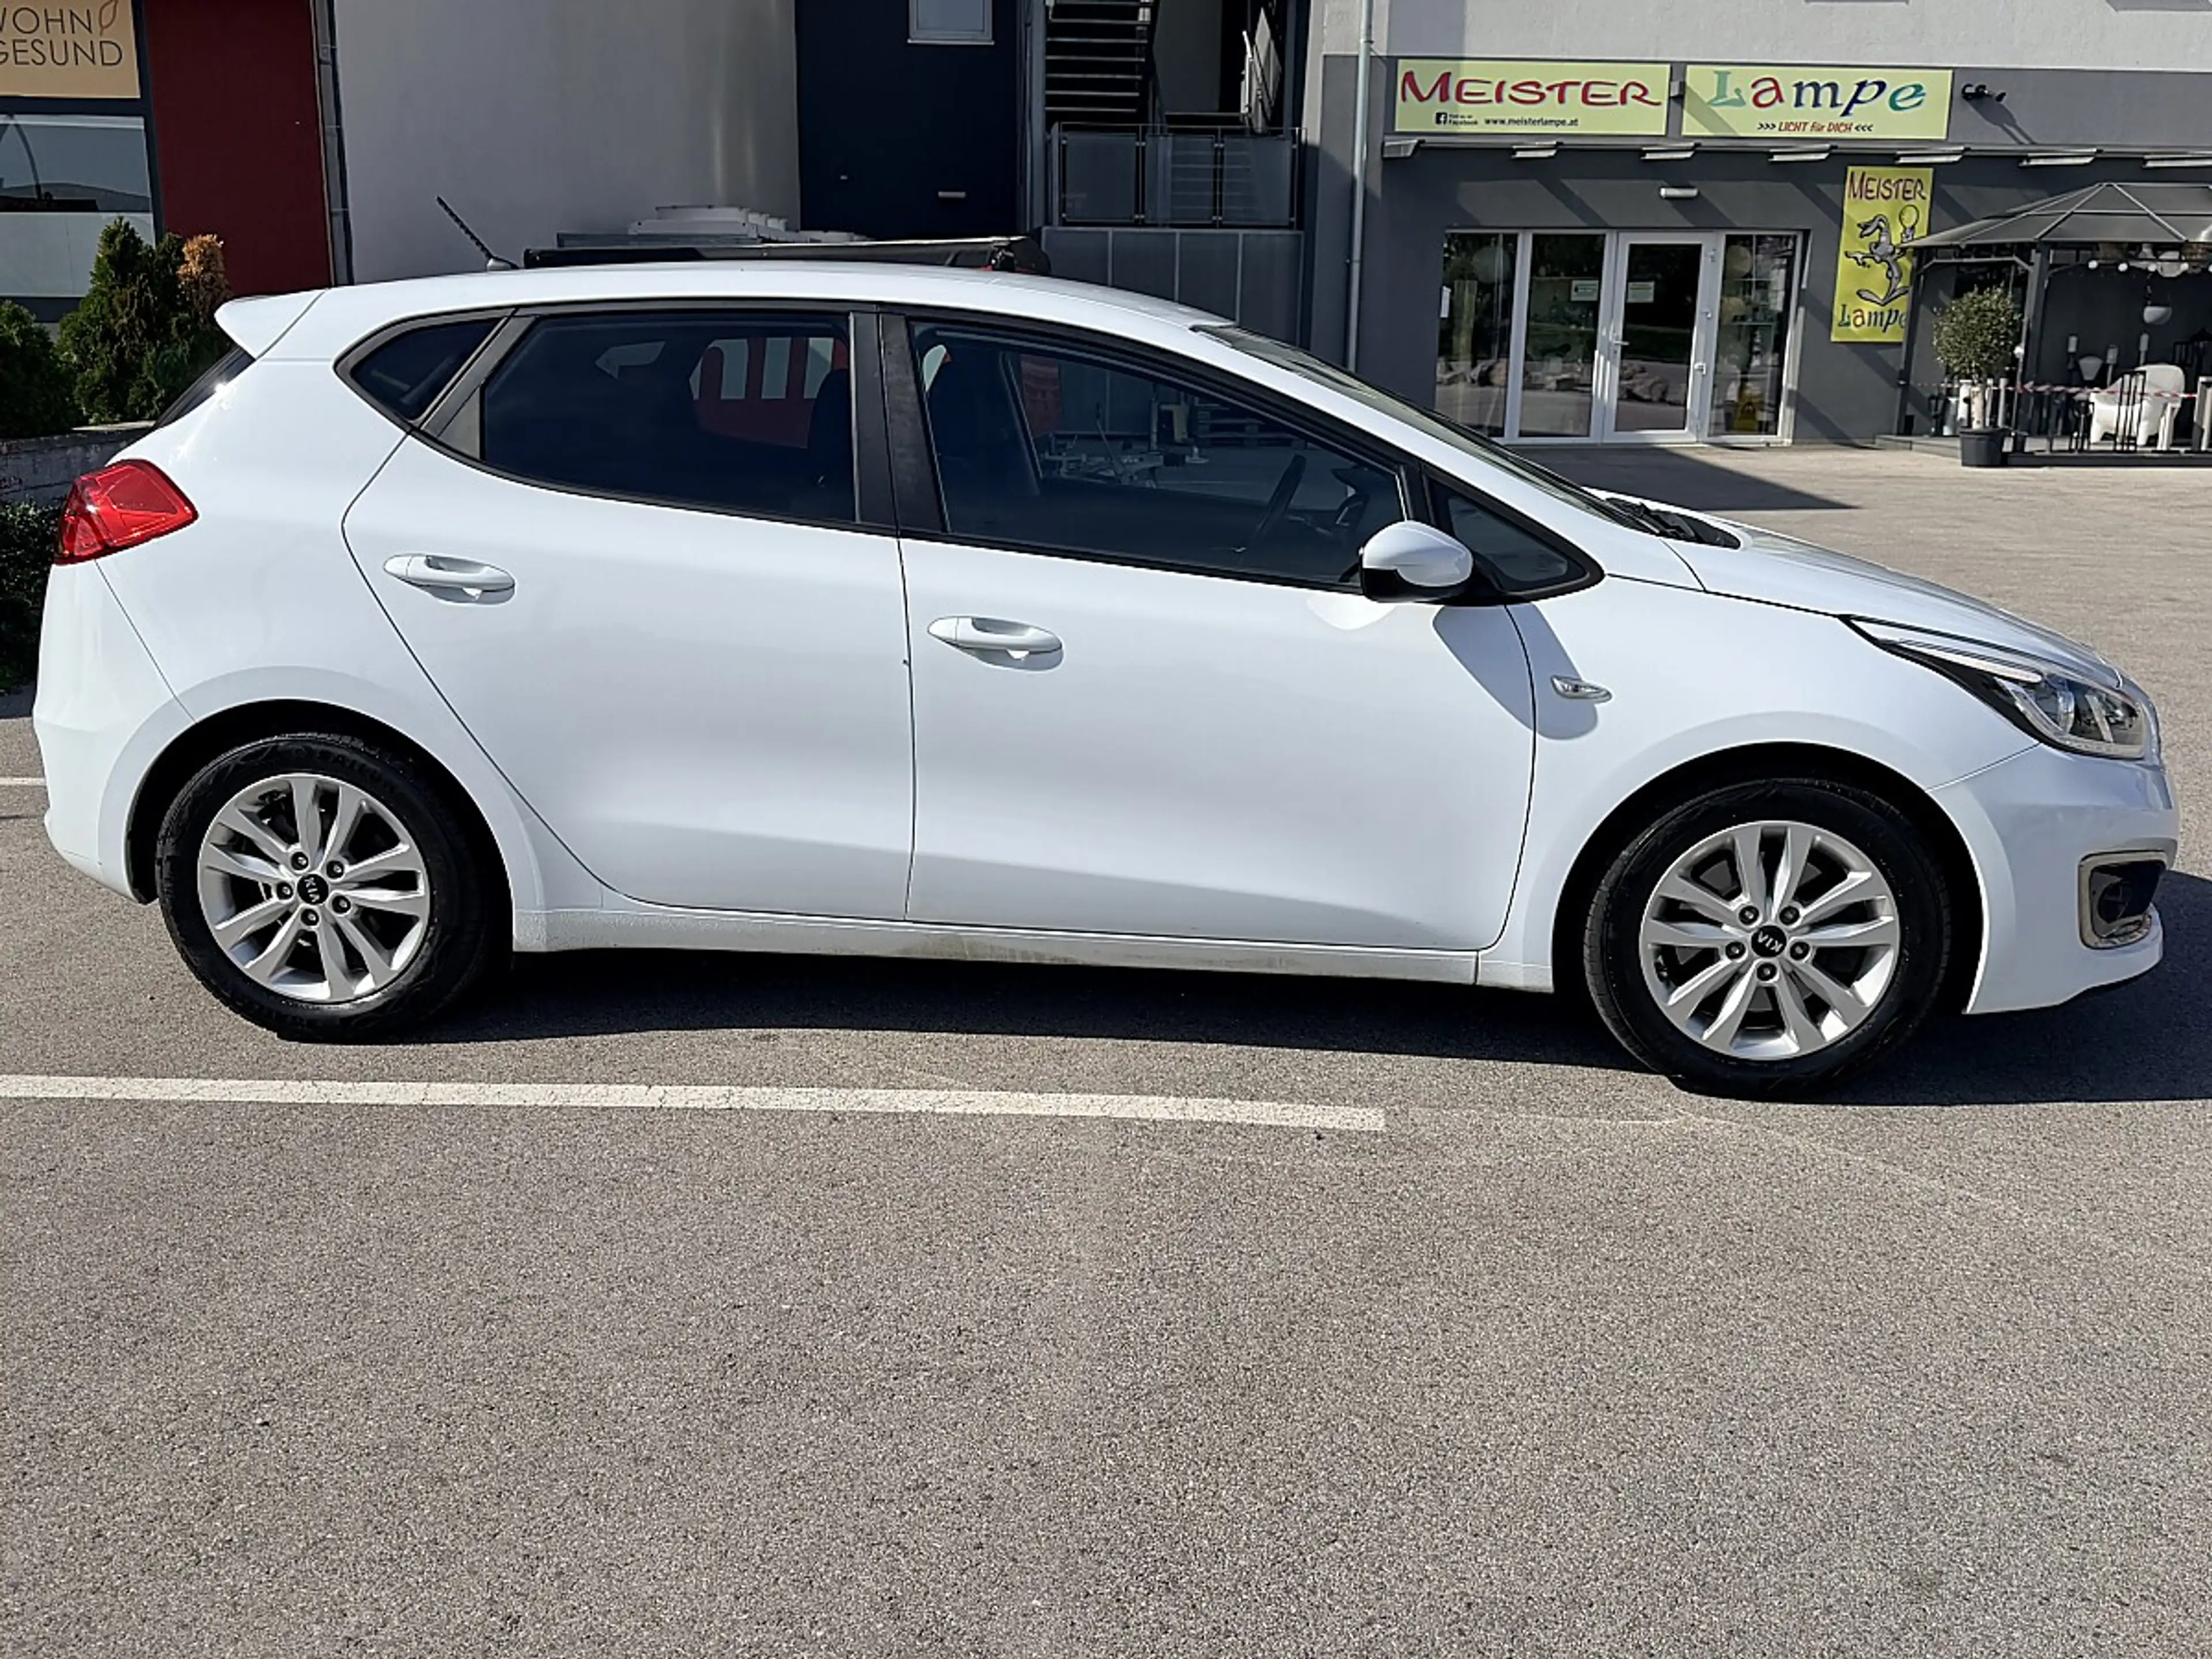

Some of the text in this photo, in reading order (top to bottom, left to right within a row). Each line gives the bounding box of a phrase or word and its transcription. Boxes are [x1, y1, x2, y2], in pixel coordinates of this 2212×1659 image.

[0, 7, 93, 34] OHN
[1400, 69, 1662, 107] MEISTER
[1706, 70, 1926, 117] Lampe
[1484, 117, 1579, 128] www.meisterlampe.at
[1778, 122, 1809, 132] LICHT
[1827, 122, 1854, 132] DICH
[1847, 171, 1927, 201] MEISTER
